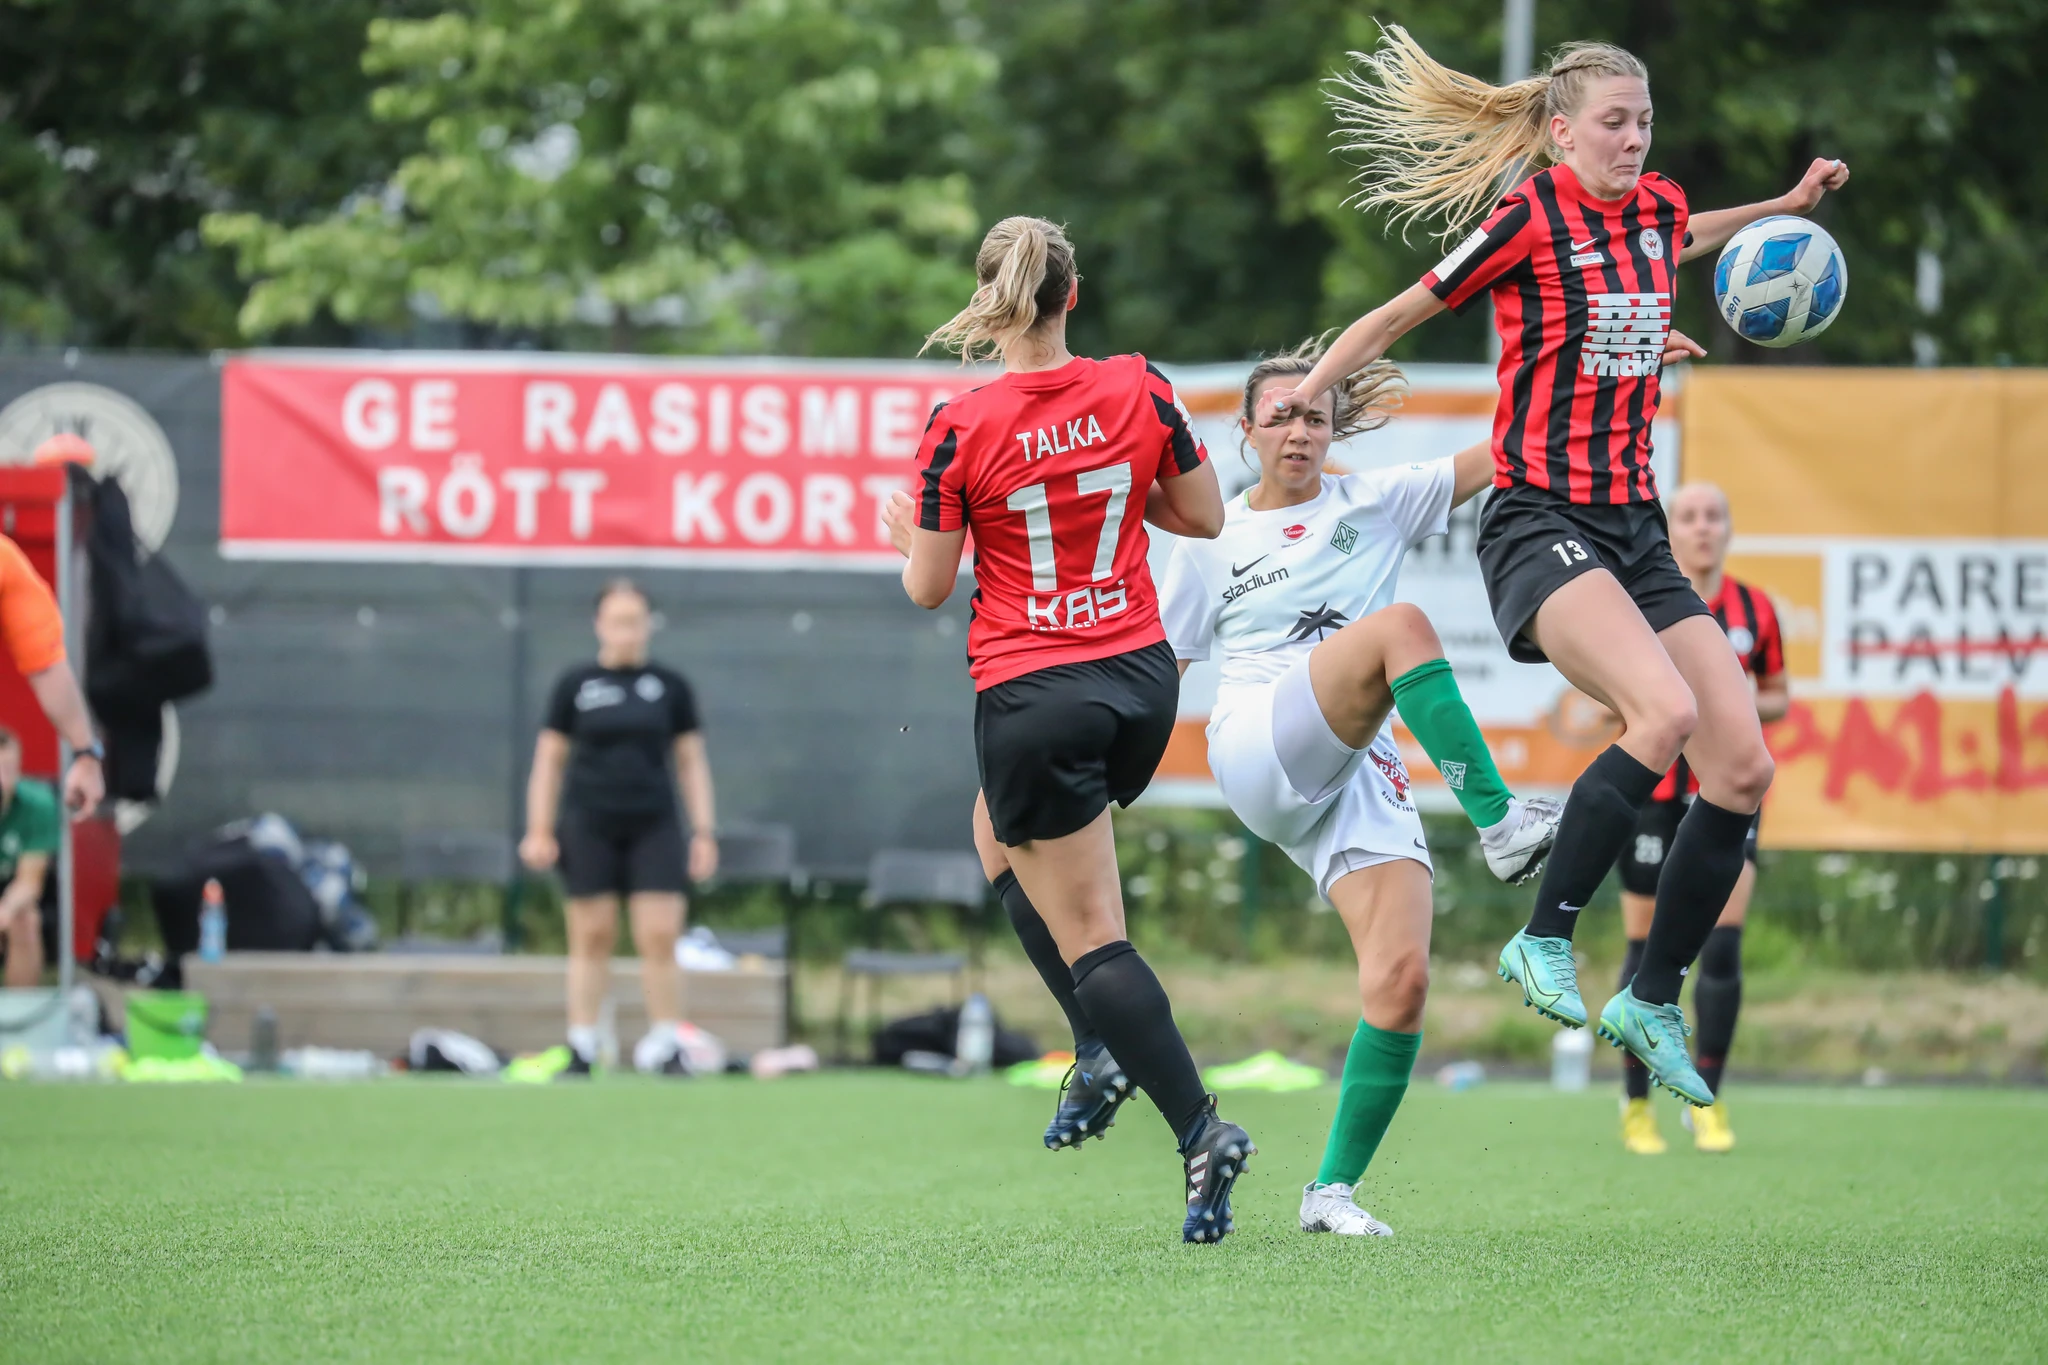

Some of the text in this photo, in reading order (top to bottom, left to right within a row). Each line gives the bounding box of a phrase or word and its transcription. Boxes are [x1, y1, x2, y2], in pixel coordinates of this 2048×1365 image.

[342, 379, 458, 451] GE
[1016, 414, 1107, 462] TALKA
[376, 453, 607, 539] RÖTT
[1007, 462, 1132, 592] 17
[1552, 540, 1588, 566] 13
[1222, 567, 1290, 603] stadium
[1381, 790, 1400, 810] SINCE
